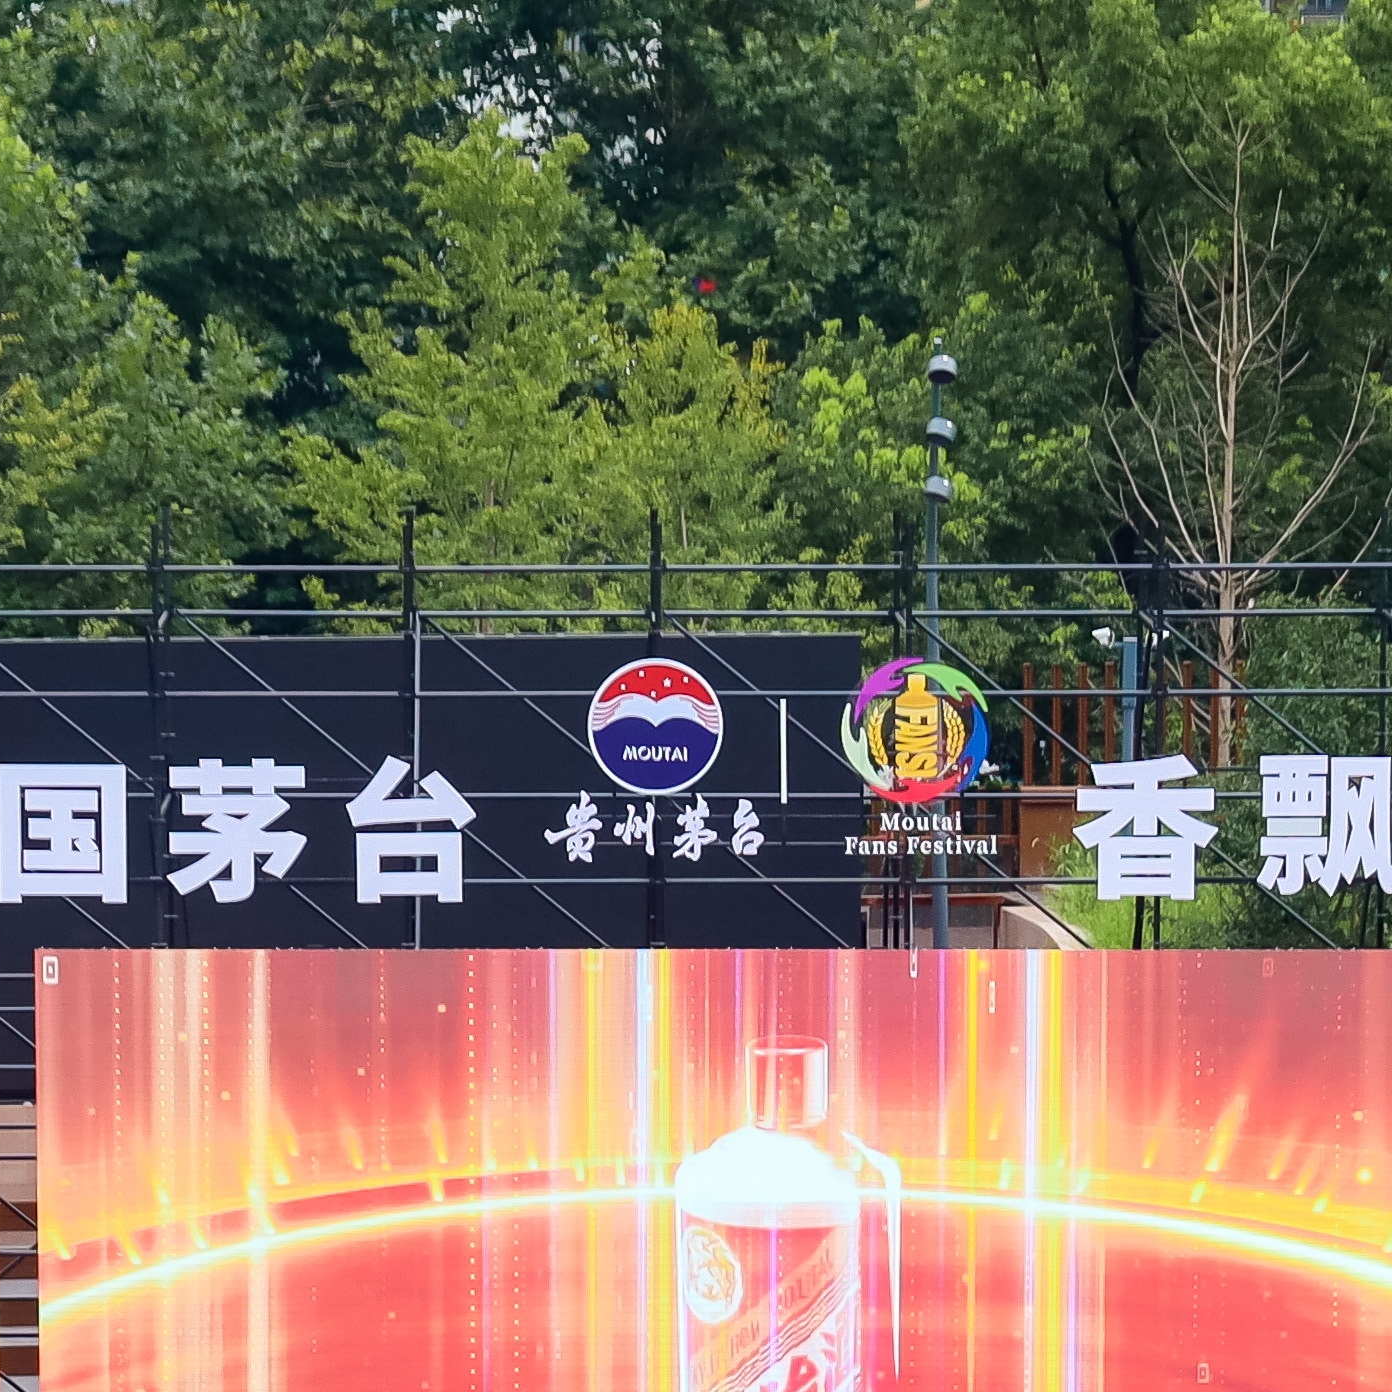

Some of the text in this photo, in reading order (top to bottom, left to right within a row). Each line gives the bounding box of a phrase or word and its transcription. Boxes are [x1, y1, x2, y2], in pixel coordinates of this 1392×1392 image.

[622, 745, 688, 763] MOUTAI
[544, 790, 766, 863] 贵州茅台
[880, 811, 962, 831] Moutai
[844, 834, 998, 855] Fans Festival
